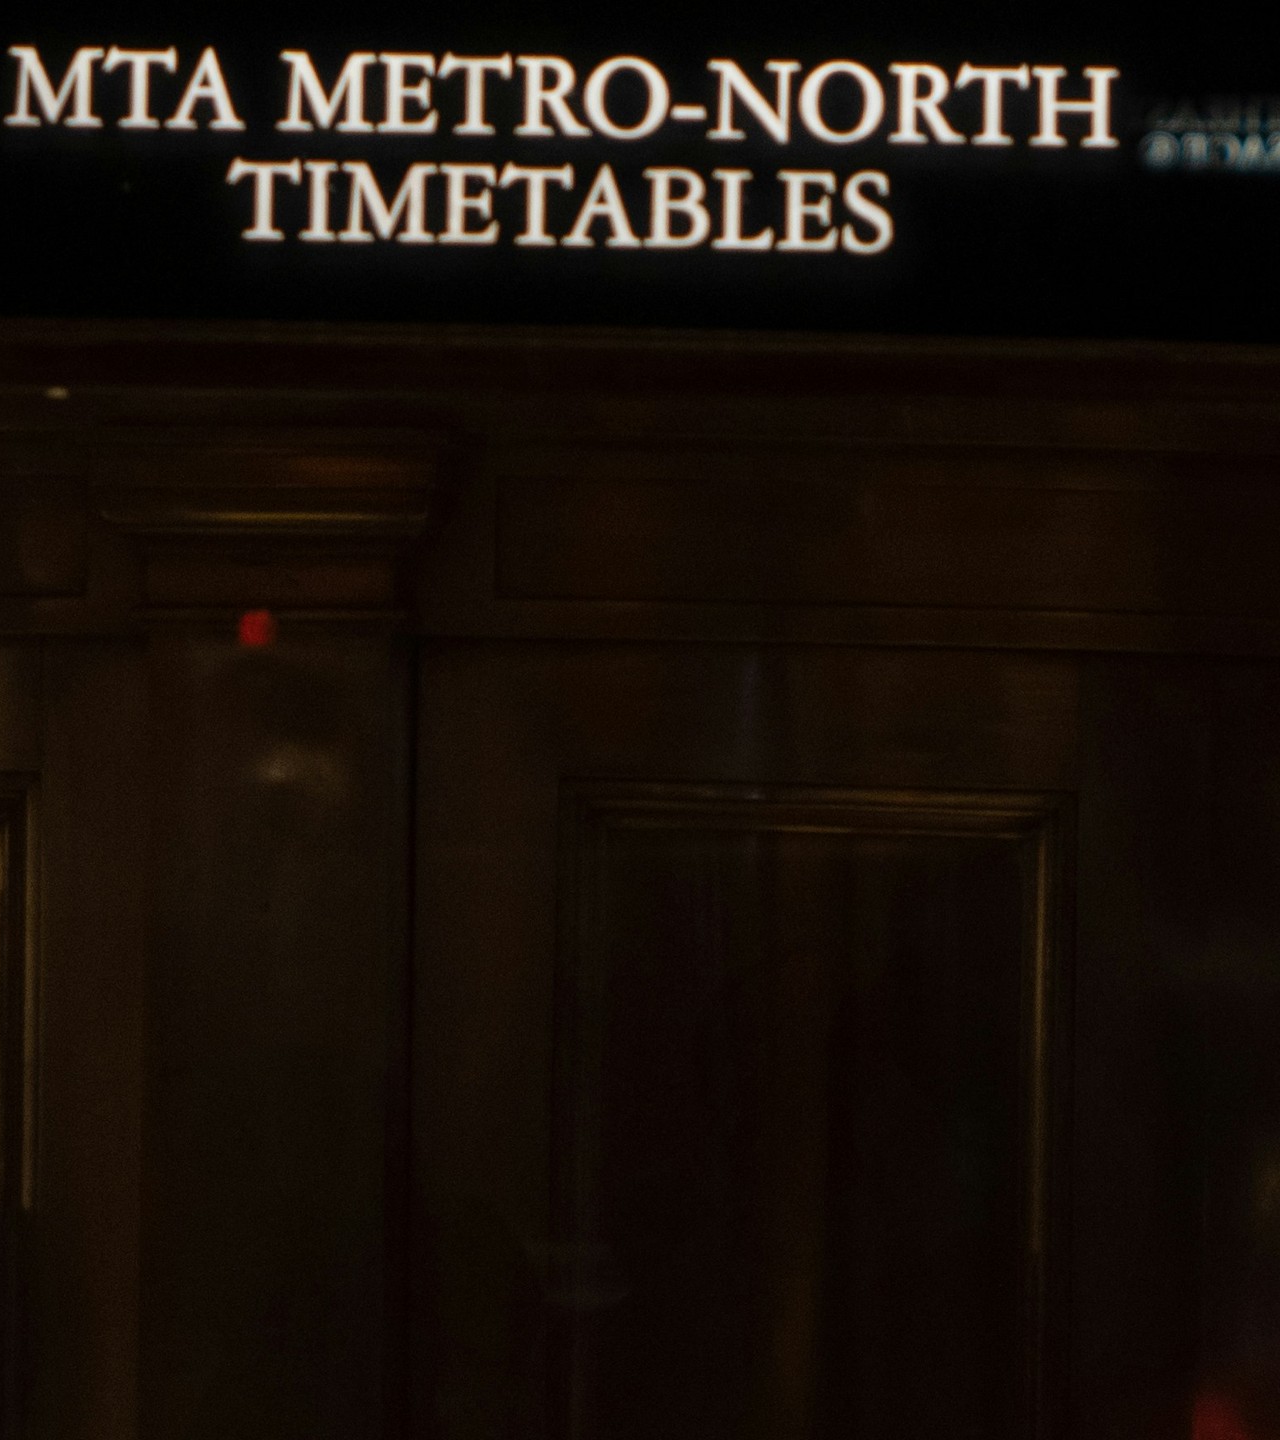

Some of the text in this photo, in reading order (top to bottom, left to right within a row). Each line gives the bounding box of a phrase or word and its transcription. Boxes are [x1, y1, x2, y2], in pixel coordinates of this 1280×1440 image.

[6, 46, 244, 130] MTA
[279, 50, 1120, 148] METRO-NORTH
[228, 158, 893, 254] TIMETABLES
